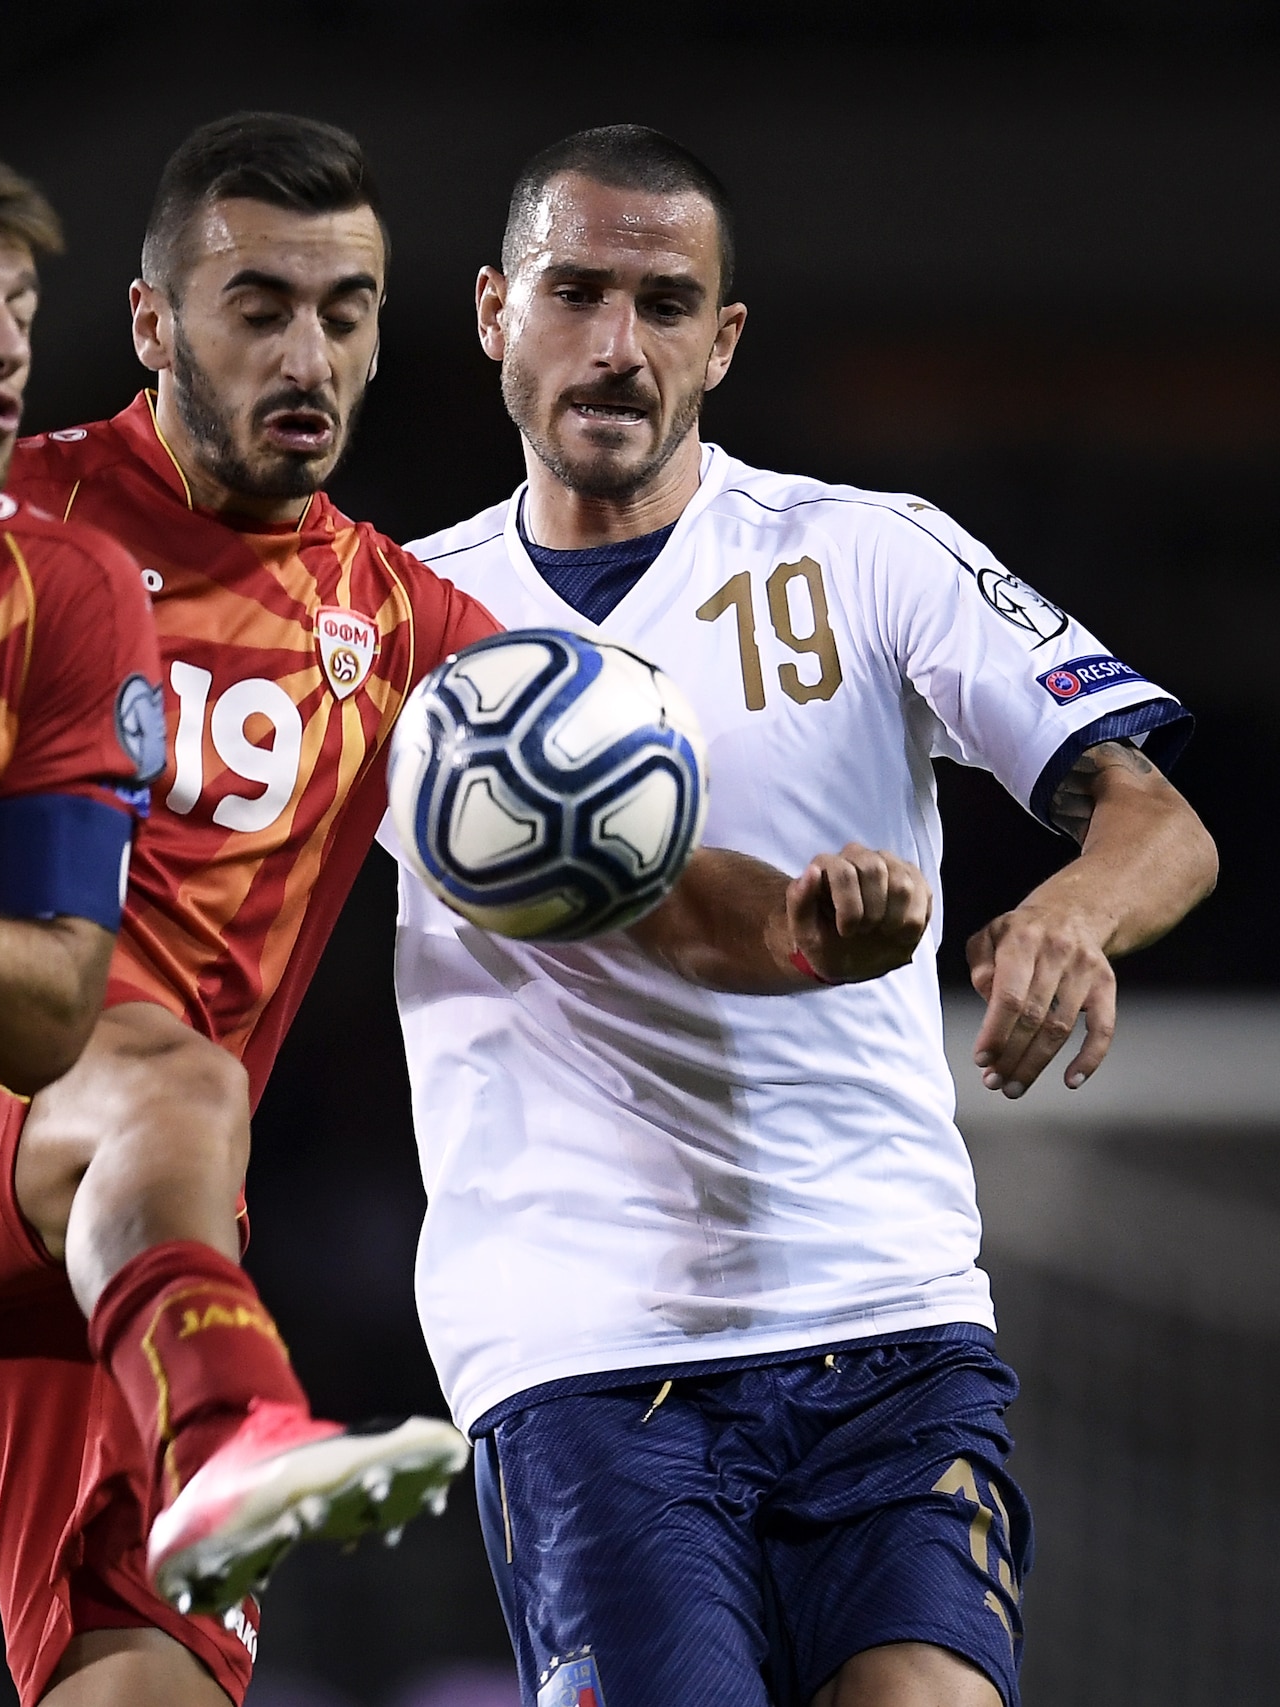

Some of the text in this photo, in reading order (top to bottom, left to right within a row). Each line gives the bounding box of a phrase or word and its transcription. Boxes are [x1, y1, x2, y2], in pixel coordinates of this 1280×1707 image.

[323, 619, 369, 648] ФФМ
[695, 555, 842, 711] 19
[165, 659, 304, 833] 19
